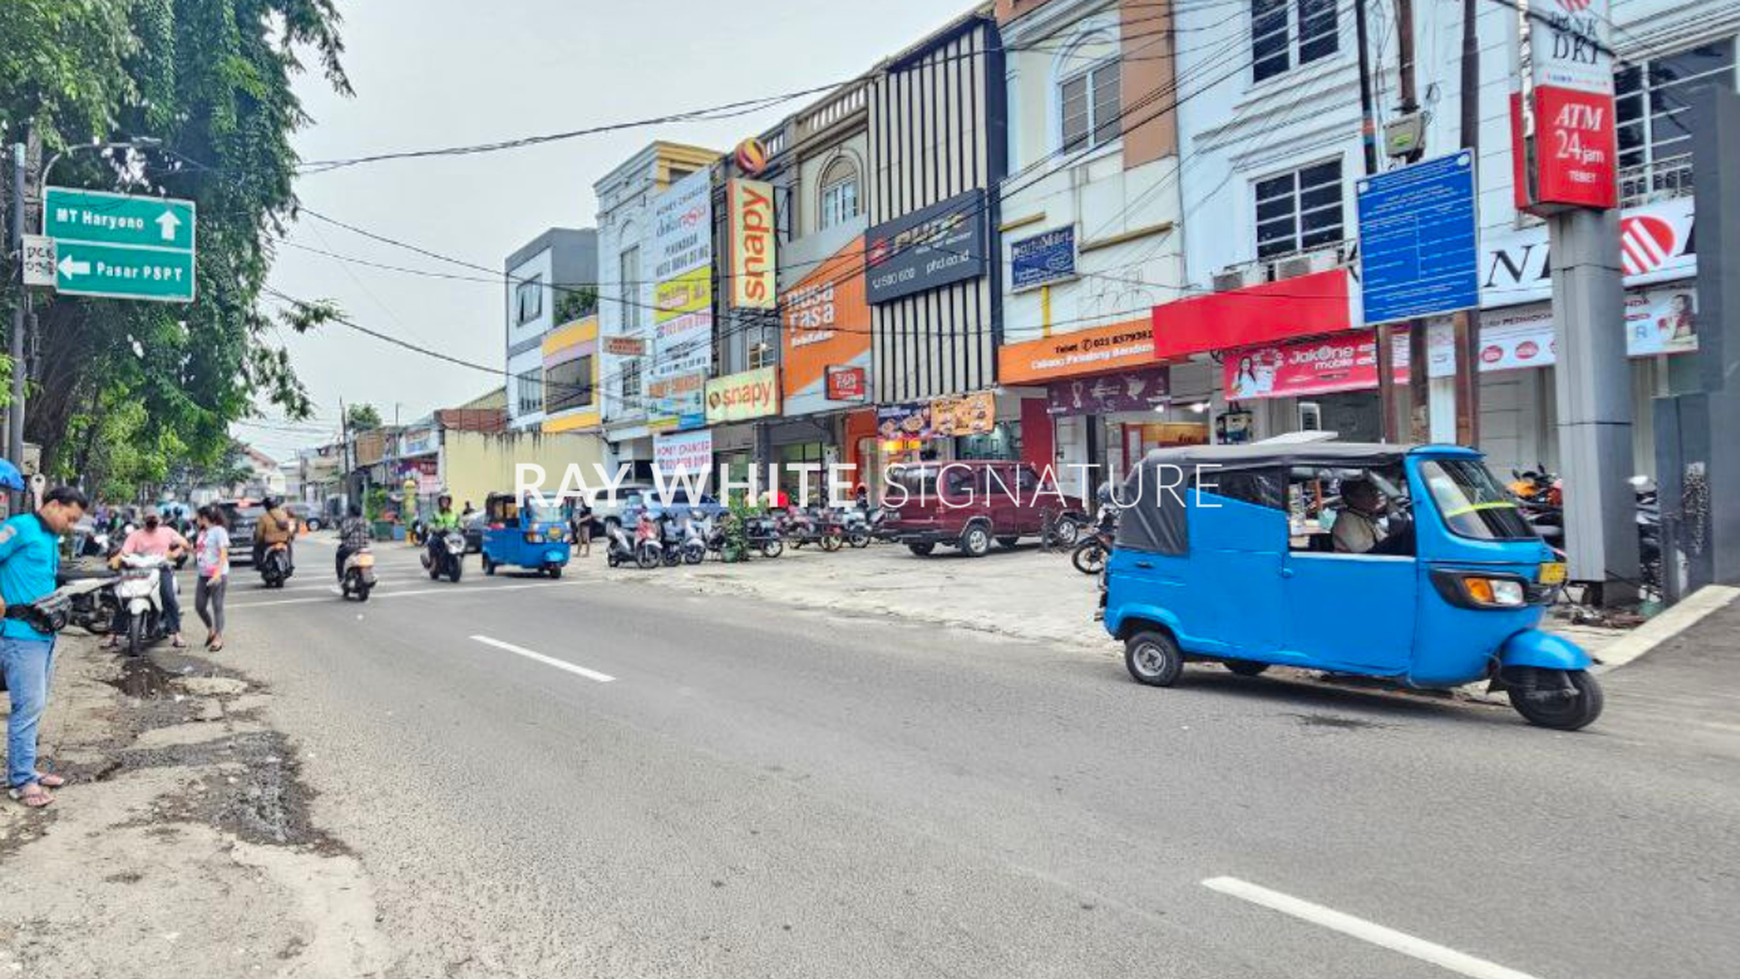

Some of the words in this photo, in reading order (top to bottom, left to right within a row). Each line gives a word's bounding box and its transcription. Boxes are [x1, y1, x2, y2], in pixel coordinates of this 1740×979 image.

[1553, 34, 1598, 64] DKI
[1554, 102, 1604, 131] ATM
[1554, 129, 1582, 160] 24
[1581, 146, 1605, 164] jam
[56, 208, 78, 223] MT
[82, 210, 144, 230] Haryono
[742, 186, 770, 300] snapy
[97, 261, 138, 279] Pasar
[142, 265, 183, 281] PSPT
[789, 303, 835, 333] rasa
[1289, 343, 1354, 366] JakOne
[1315, 357, 1353, 371] mobile
[723, 381, 772, 407] snapy
